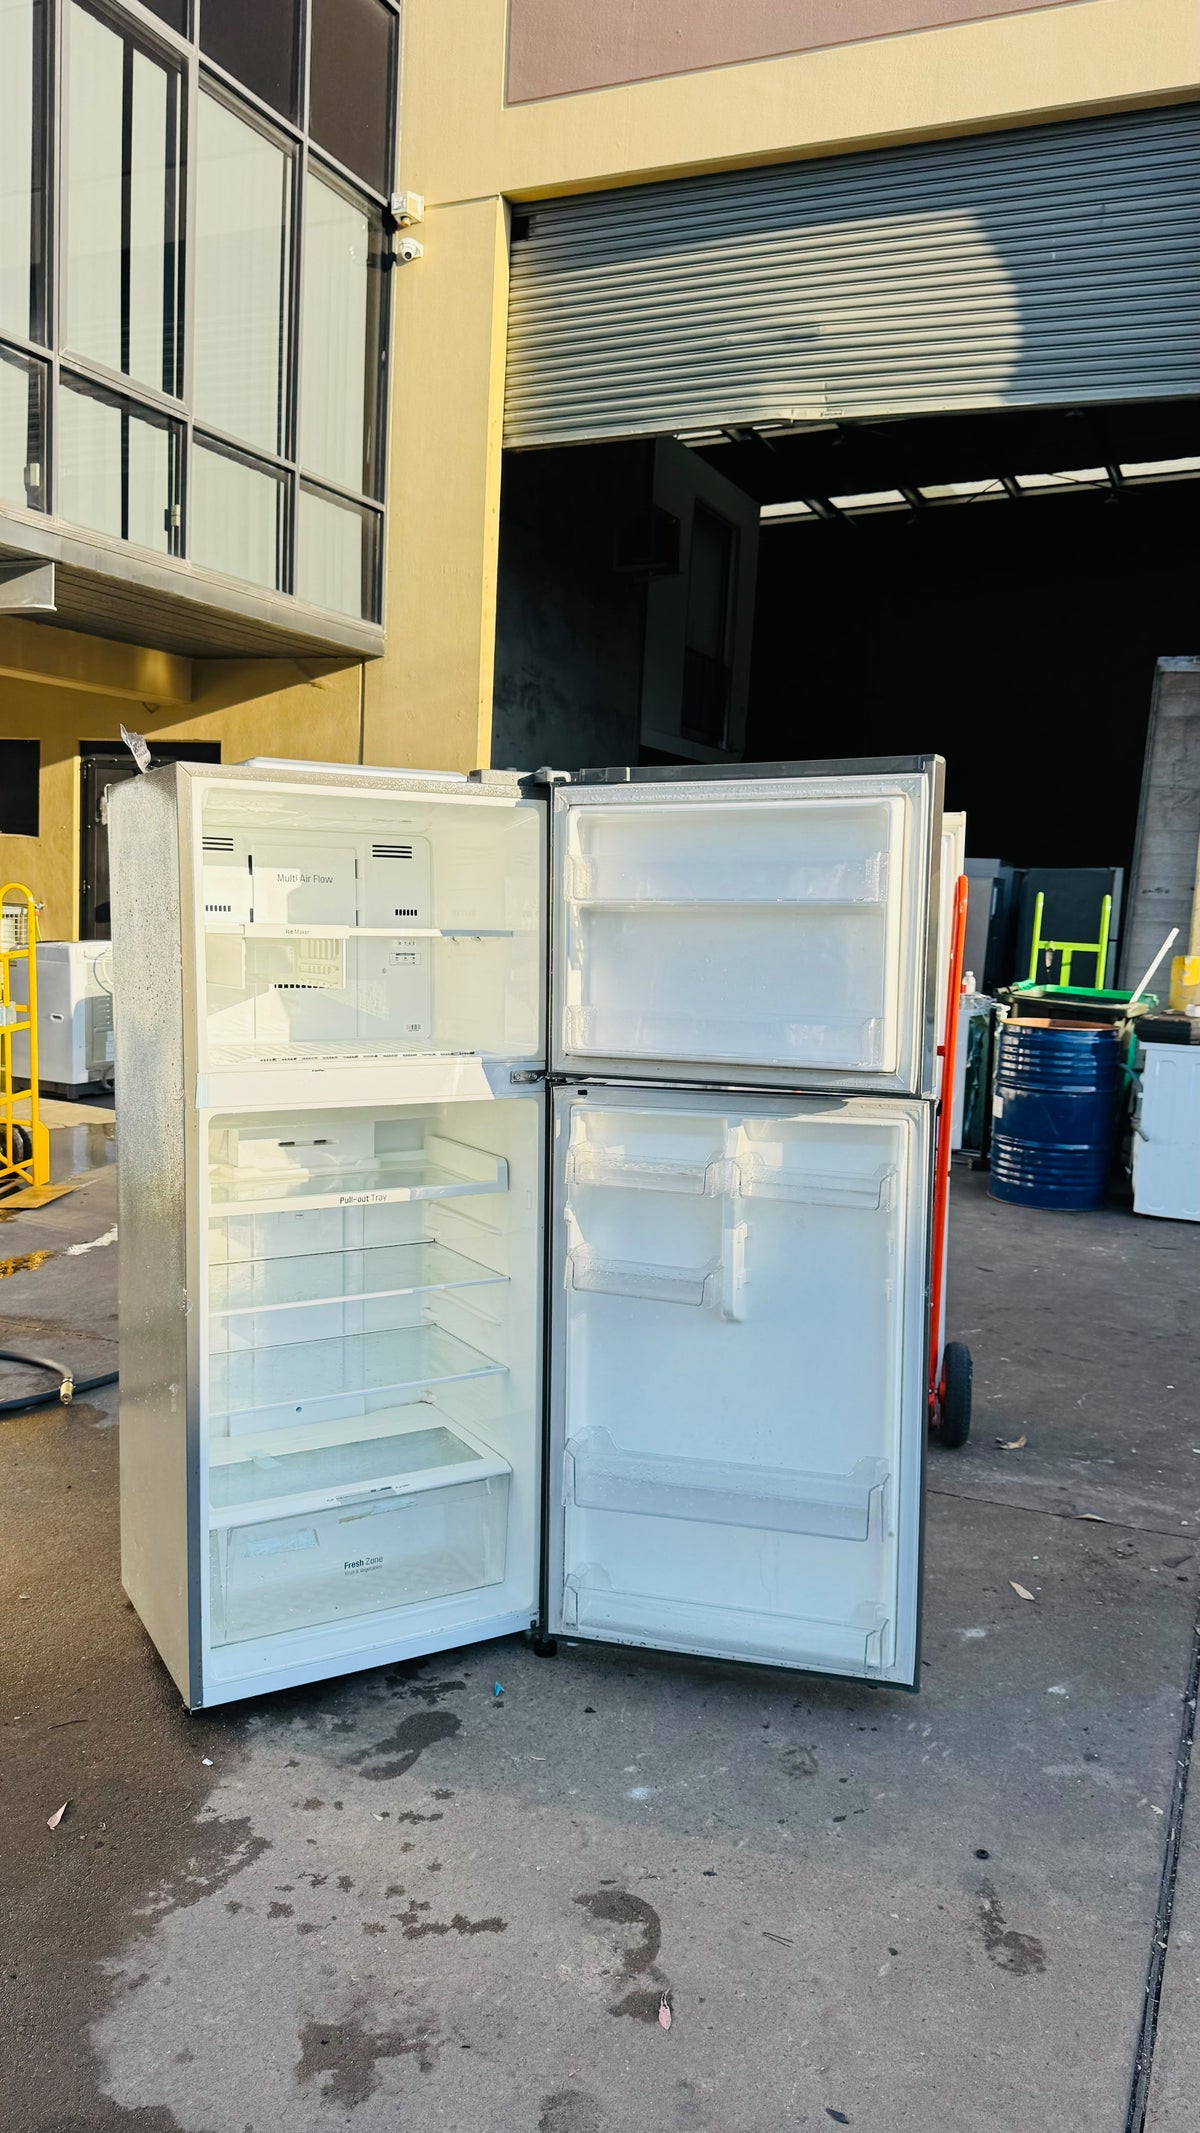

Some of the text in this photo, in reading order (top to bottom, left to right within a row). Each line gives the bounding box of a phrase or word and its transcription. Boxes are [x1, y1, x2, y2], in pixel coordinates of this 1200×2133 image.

[277, 873, 334, 884] Multi Air Flow
[340, 1194, 387, 1205] Pull-out Tray
[344, 1556, 384, 1570] Fresh Zone
